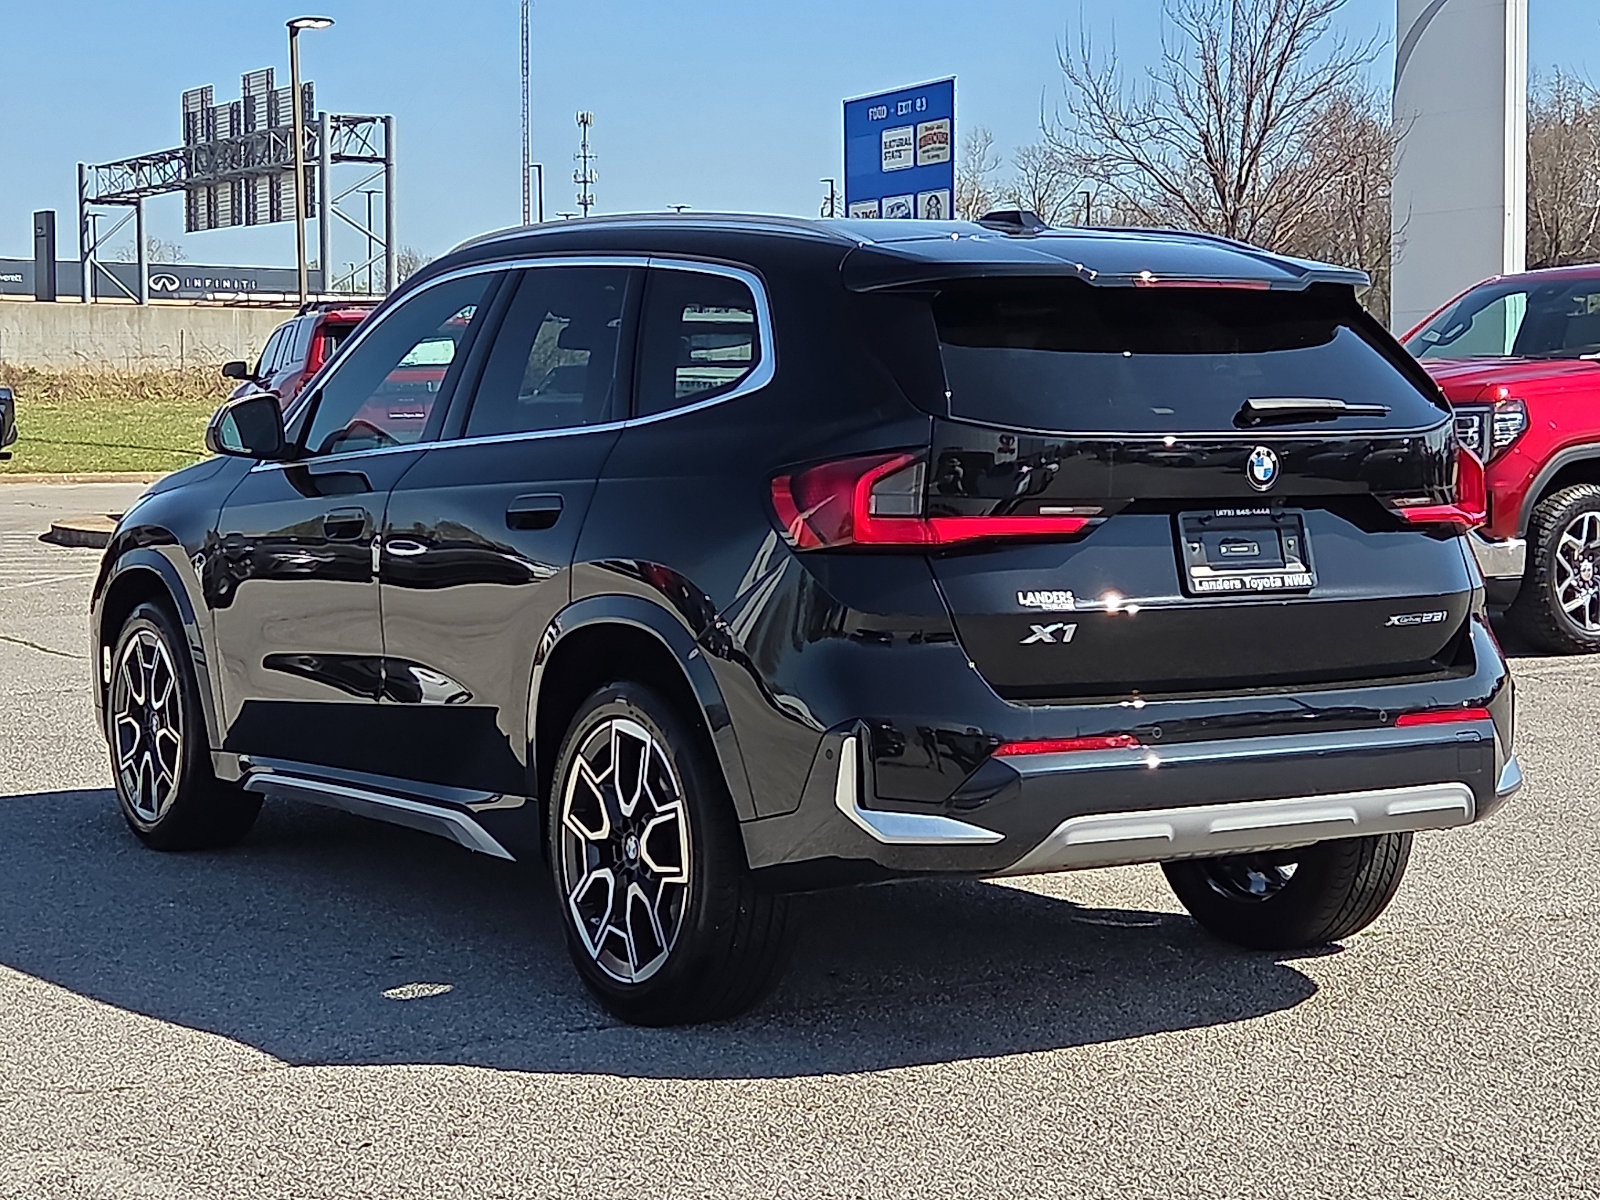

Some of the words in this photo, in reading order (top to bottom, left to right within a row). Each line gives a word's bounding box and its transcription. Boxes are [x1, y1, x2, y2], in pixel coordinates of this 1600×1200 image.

[868, 106, 887, 120] FOOD
[897, 100, 912, 115] EXIT
[884, 136, 912, 149] NATURAL
[185, 278, 256, 290] INFINITI
[1192, 577, 1241, 591] Landers
[1242, 576, 1282, 590] Toyota
[1284, 573, 1313, 587] NWA
[1017, 591, 1074, 605] LANDERS
[1019, 623, 1078, 644] X1
